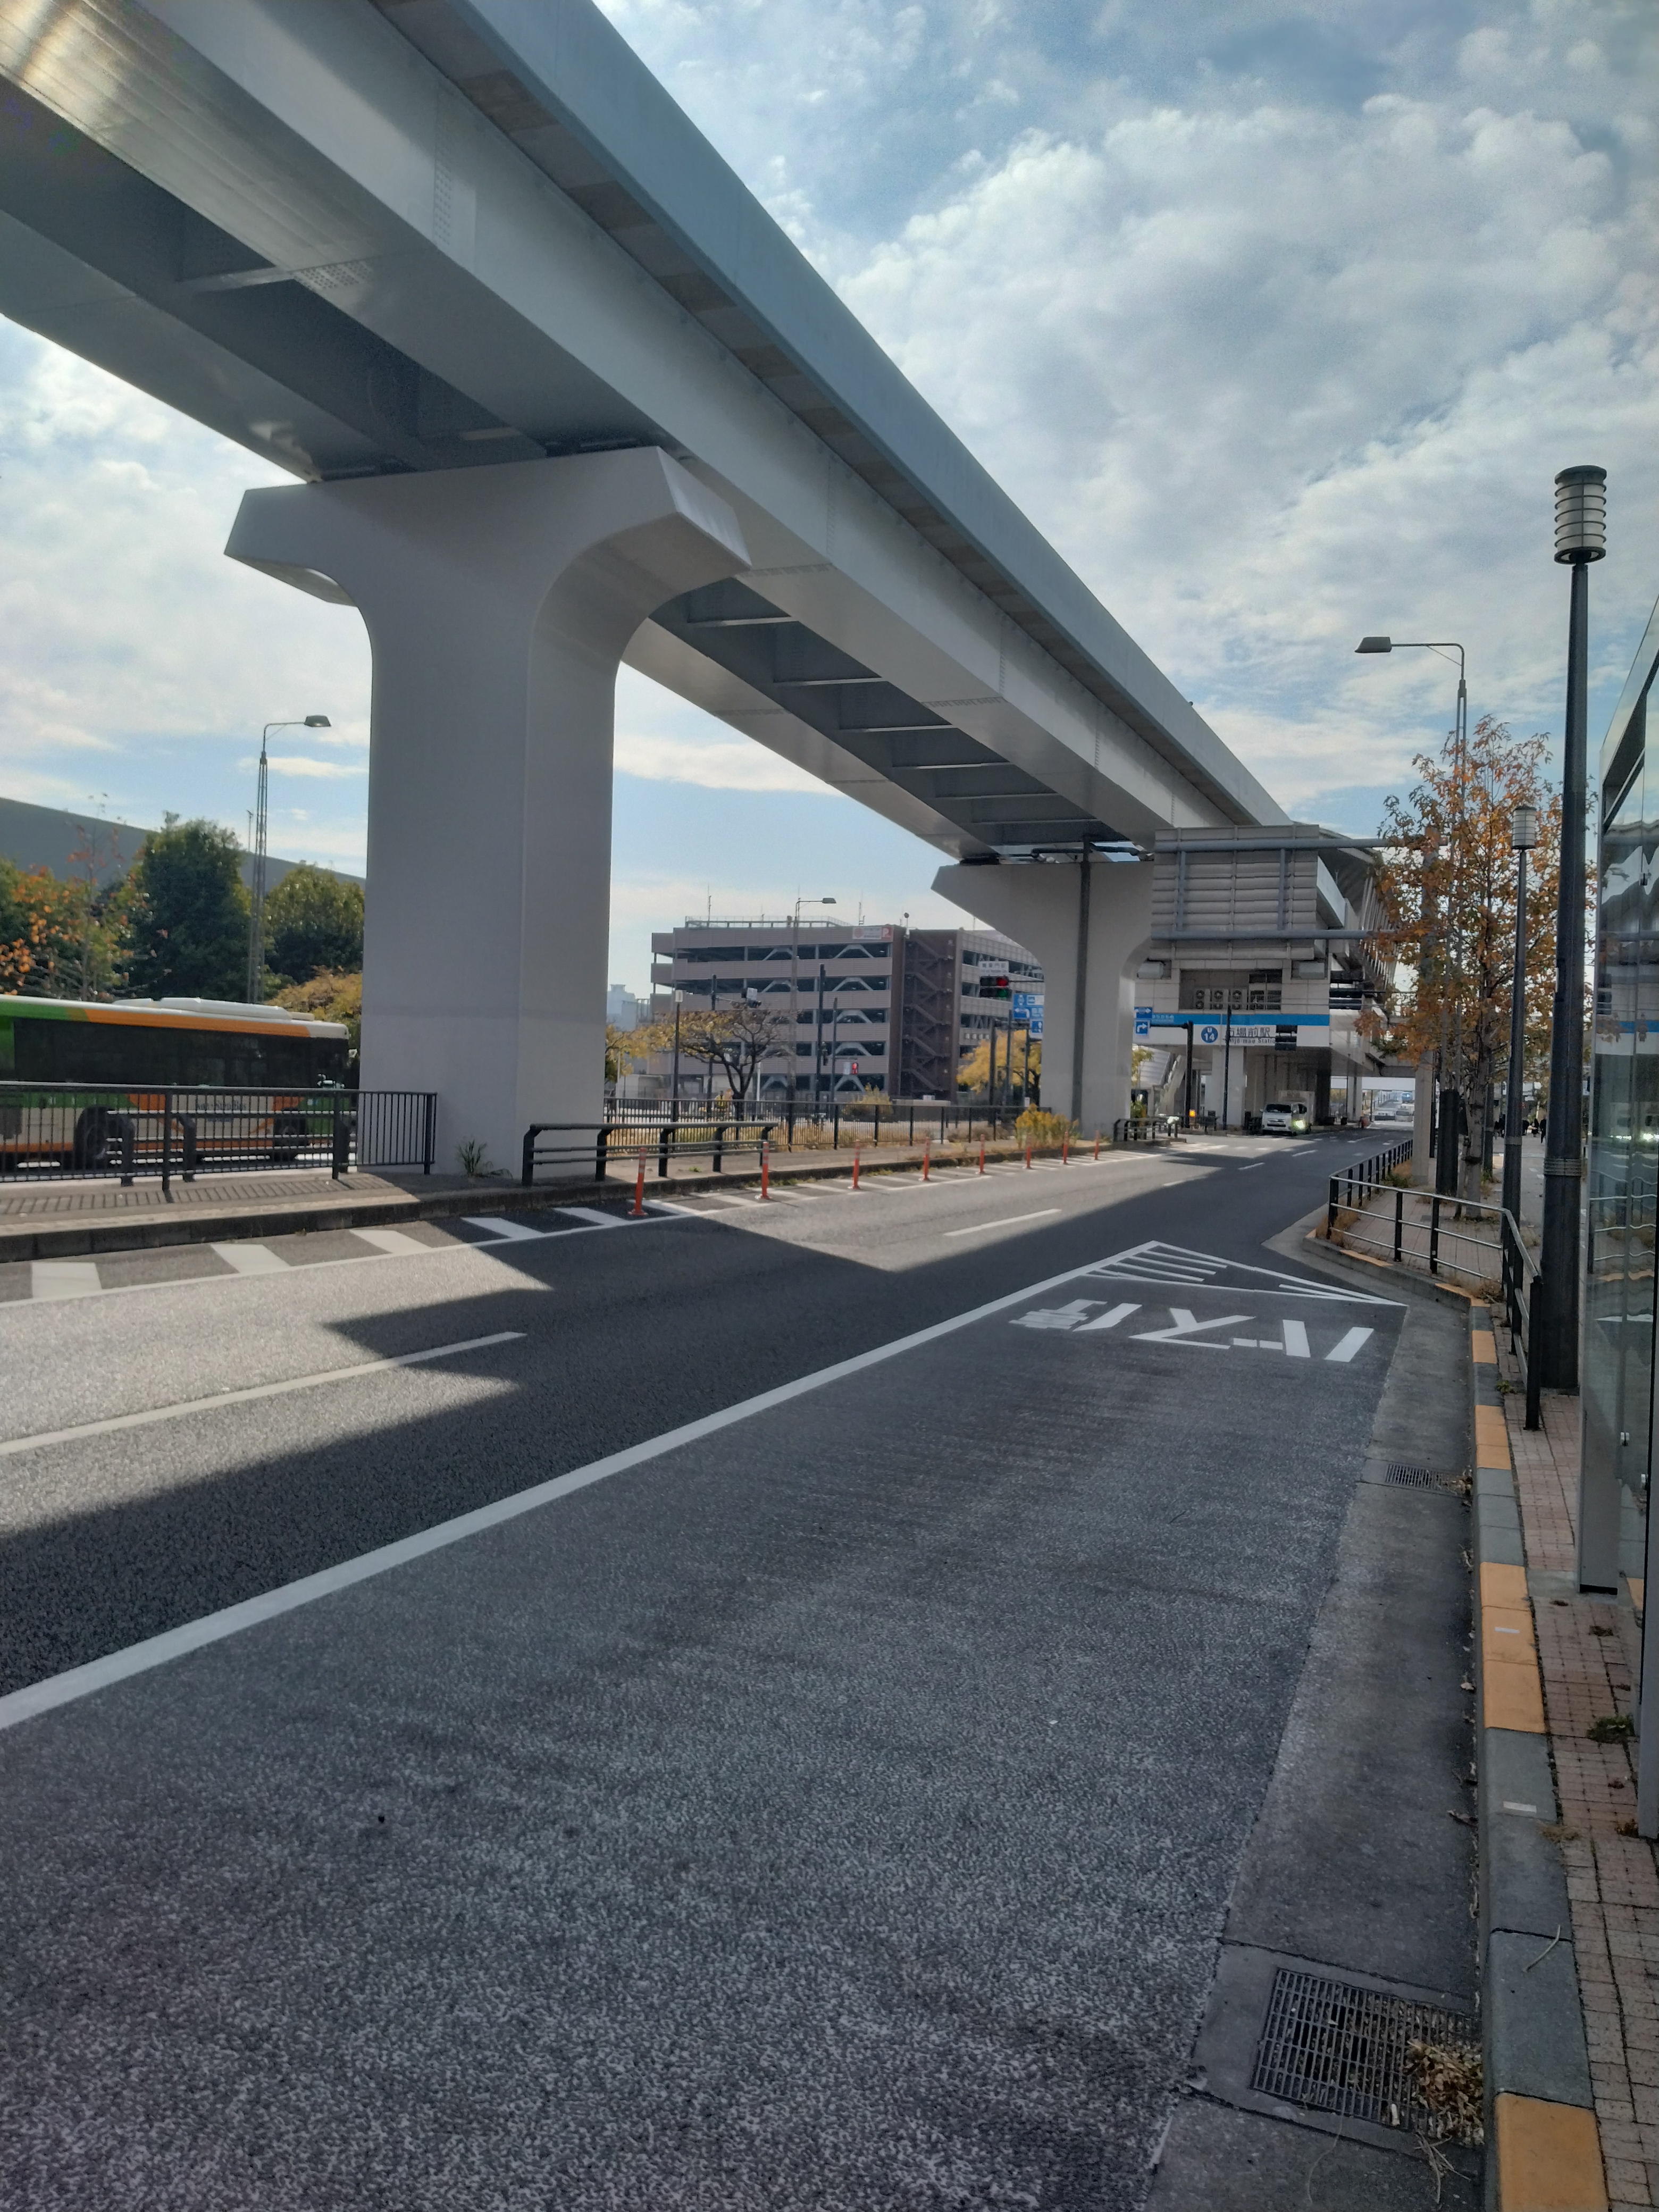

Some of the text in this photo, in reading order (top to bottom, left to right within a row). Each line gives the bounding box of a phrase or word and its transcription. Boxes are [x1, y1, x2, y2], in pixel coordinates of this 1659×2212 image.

[1204, 1033, 1215, 1041] 14
[1008, 1299, 1374, 1362] バス停
